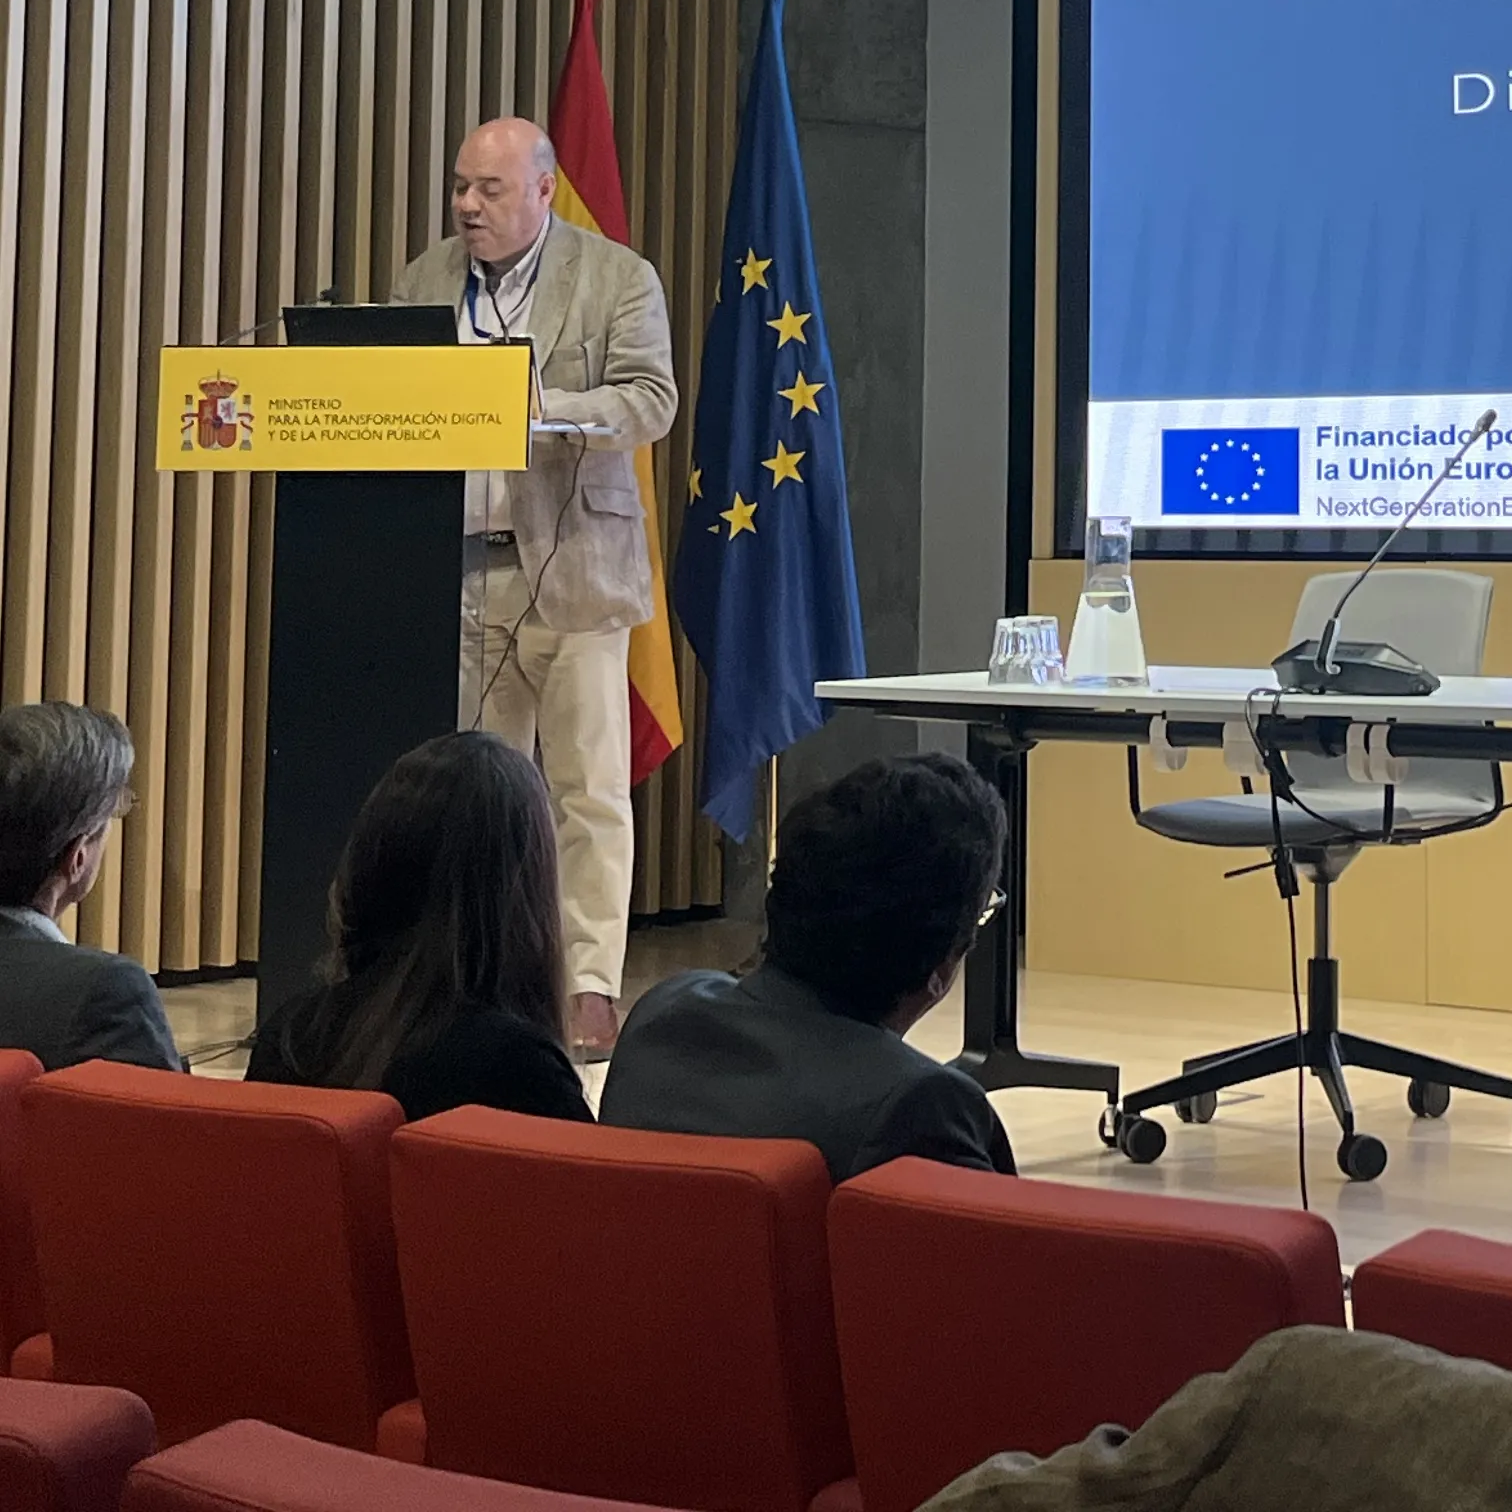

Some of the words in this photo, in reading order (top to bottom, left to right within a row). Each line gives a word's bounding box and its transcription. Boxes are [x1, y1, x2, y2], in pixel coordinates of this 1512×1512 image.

[268, 399, 341, 410] MINISTERIO
[268, 414, 300, 425] PARA
[304, 414, 321, 425] LA
[324, 410, 447, 425] TRANSFORMACIÓN
[451, 412, 502, 425] DIGITAL
[268, 429, 276, 441] Y
[279, 429, 297, 441] DE
[301, 429, 317, 441] LA
[321, 426, 382, 441] FUNCIÓN
[387, 426, 441, 441] PÚBLICA
[1316, 424, 1475, 447] Financiado
[1316, 458, 1339, 481] la
[1349, 456, 1434, 481] Unión
